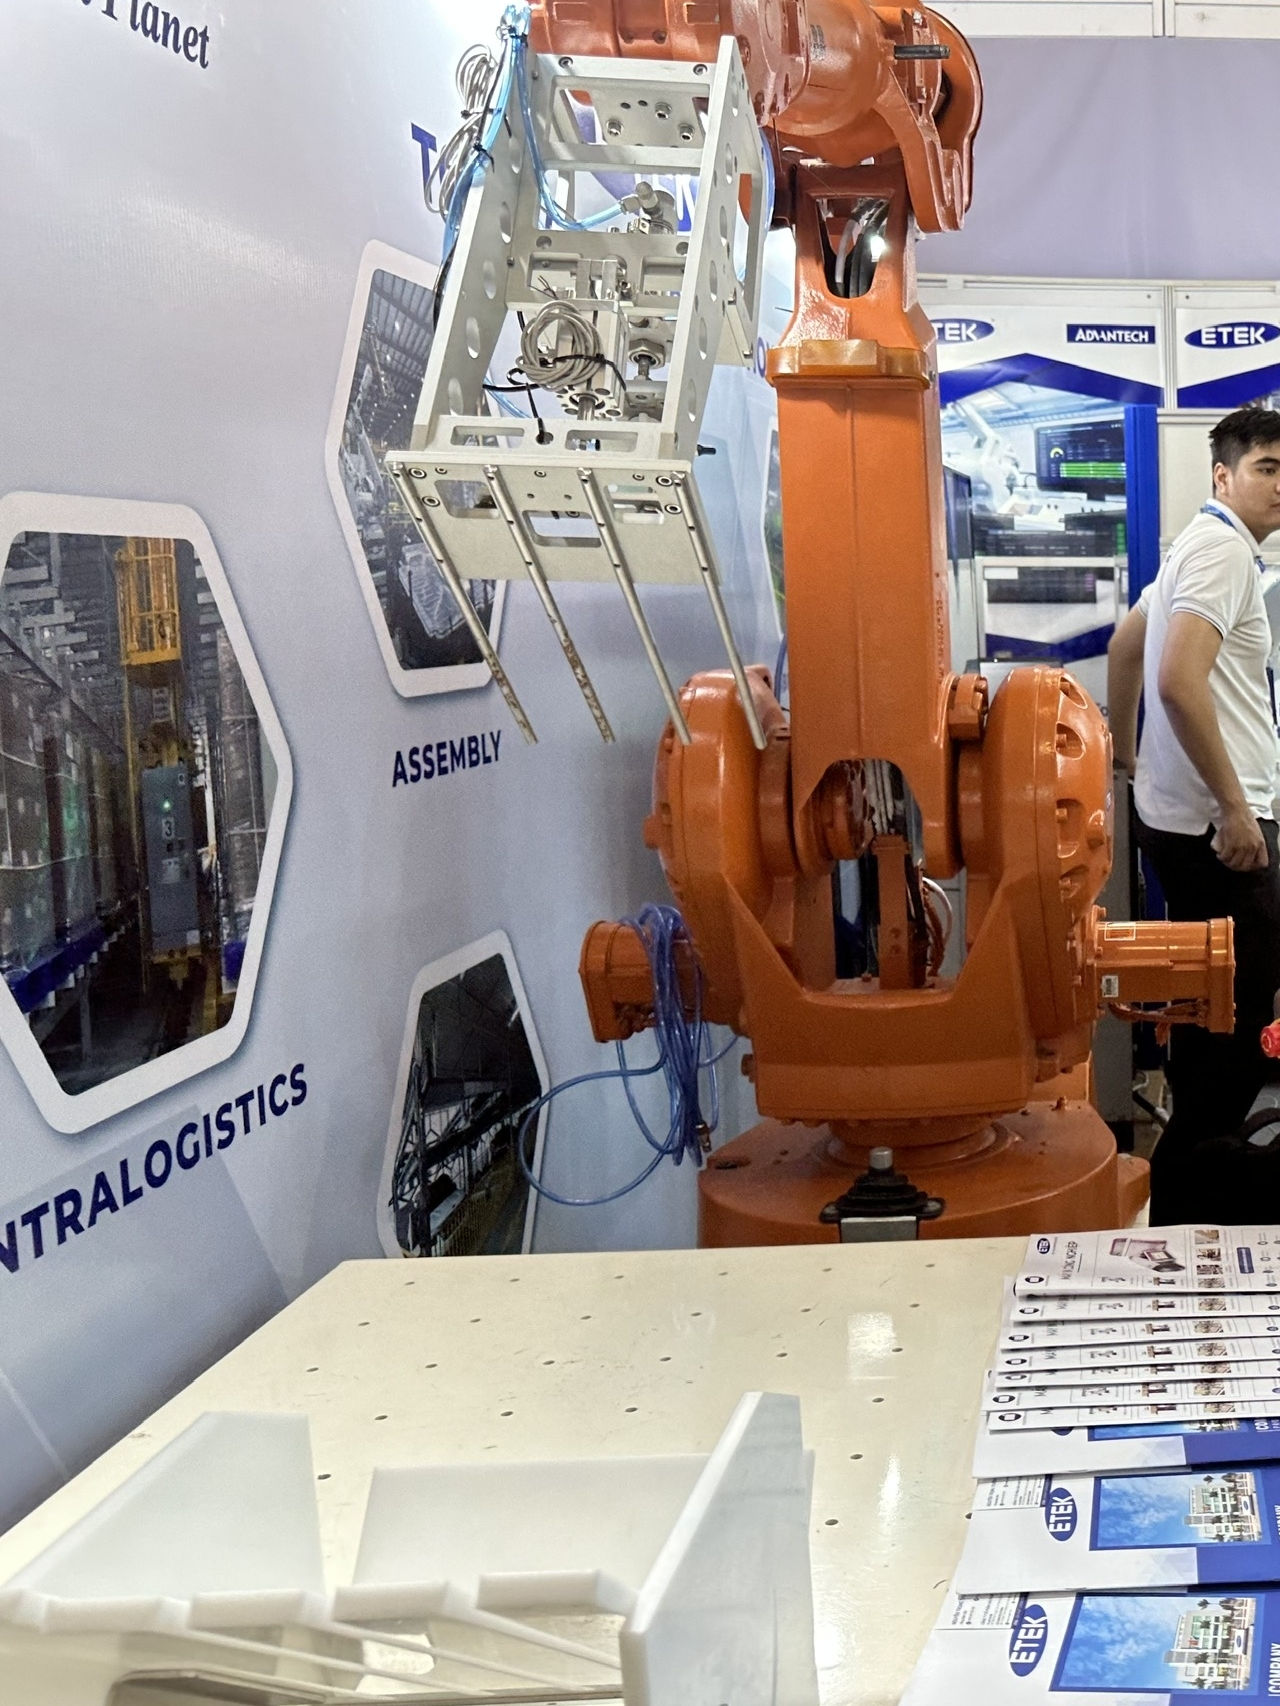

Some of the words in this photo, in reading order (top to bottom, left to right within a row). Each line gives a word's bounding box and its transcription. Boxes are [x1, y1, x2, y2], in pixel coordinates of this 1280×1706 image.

[101, 0, 209, 69] lanet
[1075, 328, 1149, 343] ADVANTECH
[1200, 327, 1266, 345] ETEK
[392, 729, 502, 788] ASSEMBLY
[1048, 1496, 1074, 1532] ETEK
[1009, 1616, 1048, 1664] ETEK
